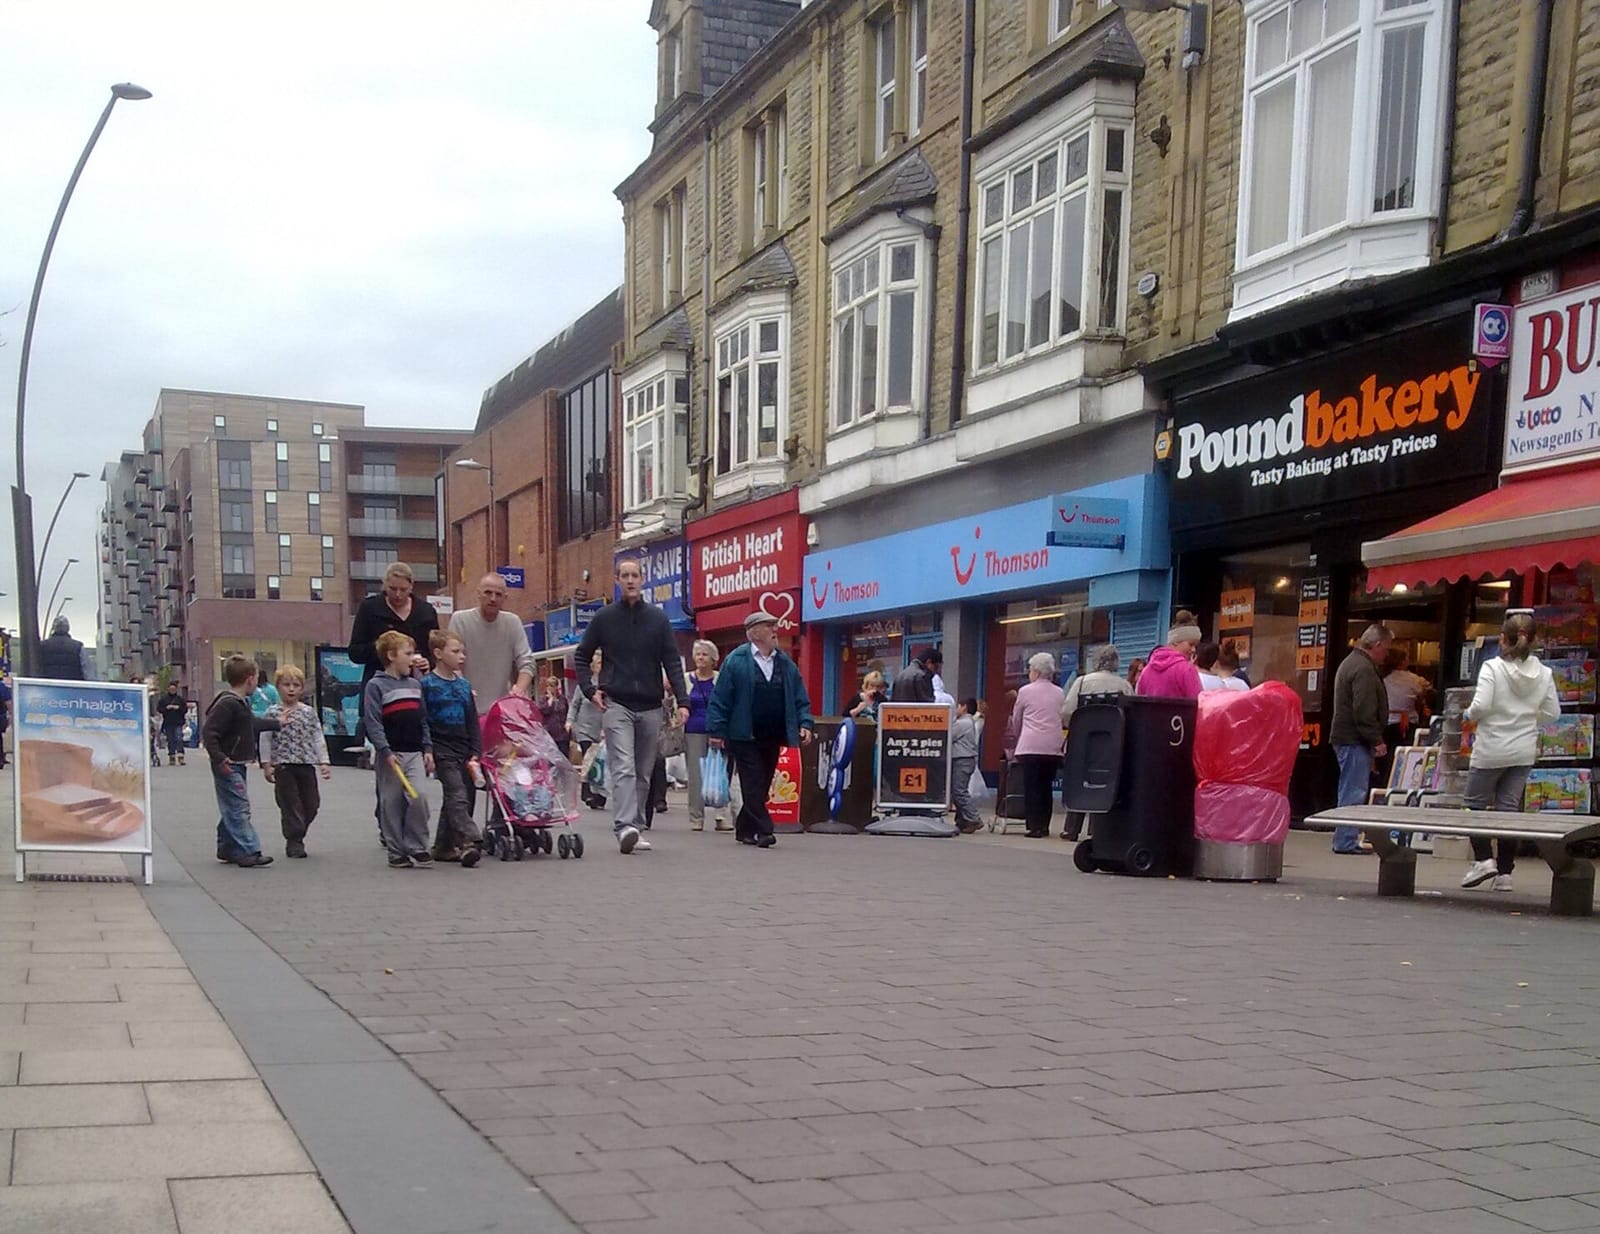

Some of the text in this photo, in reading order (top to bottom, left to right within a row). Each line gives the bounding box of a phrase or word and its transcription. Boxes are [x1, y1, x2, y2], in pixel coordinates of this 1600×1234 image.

[1523, 298, 1600, 401] BU
[1177, 365, 1480, 479] Poundbakery
[1509, 428, 1583, 456] Newsagents
[1250, 433, 1438, 487] Tasty Baking at Tasty Prices
[1082, 514, 1120, 526] Thomson
[702, 527, 783, 571] British Heart
[985, 547, 1049, 577] Thomson
[705, 563, 778, 598] Foundation
[833, 582, 880, 603] Thomson
[886, 738, 943, 748] Any 2 pies
[1169, 715, 1185, 746] 9
[888, 749, 901, 757] or
[904, 774, 922, 787] £1
